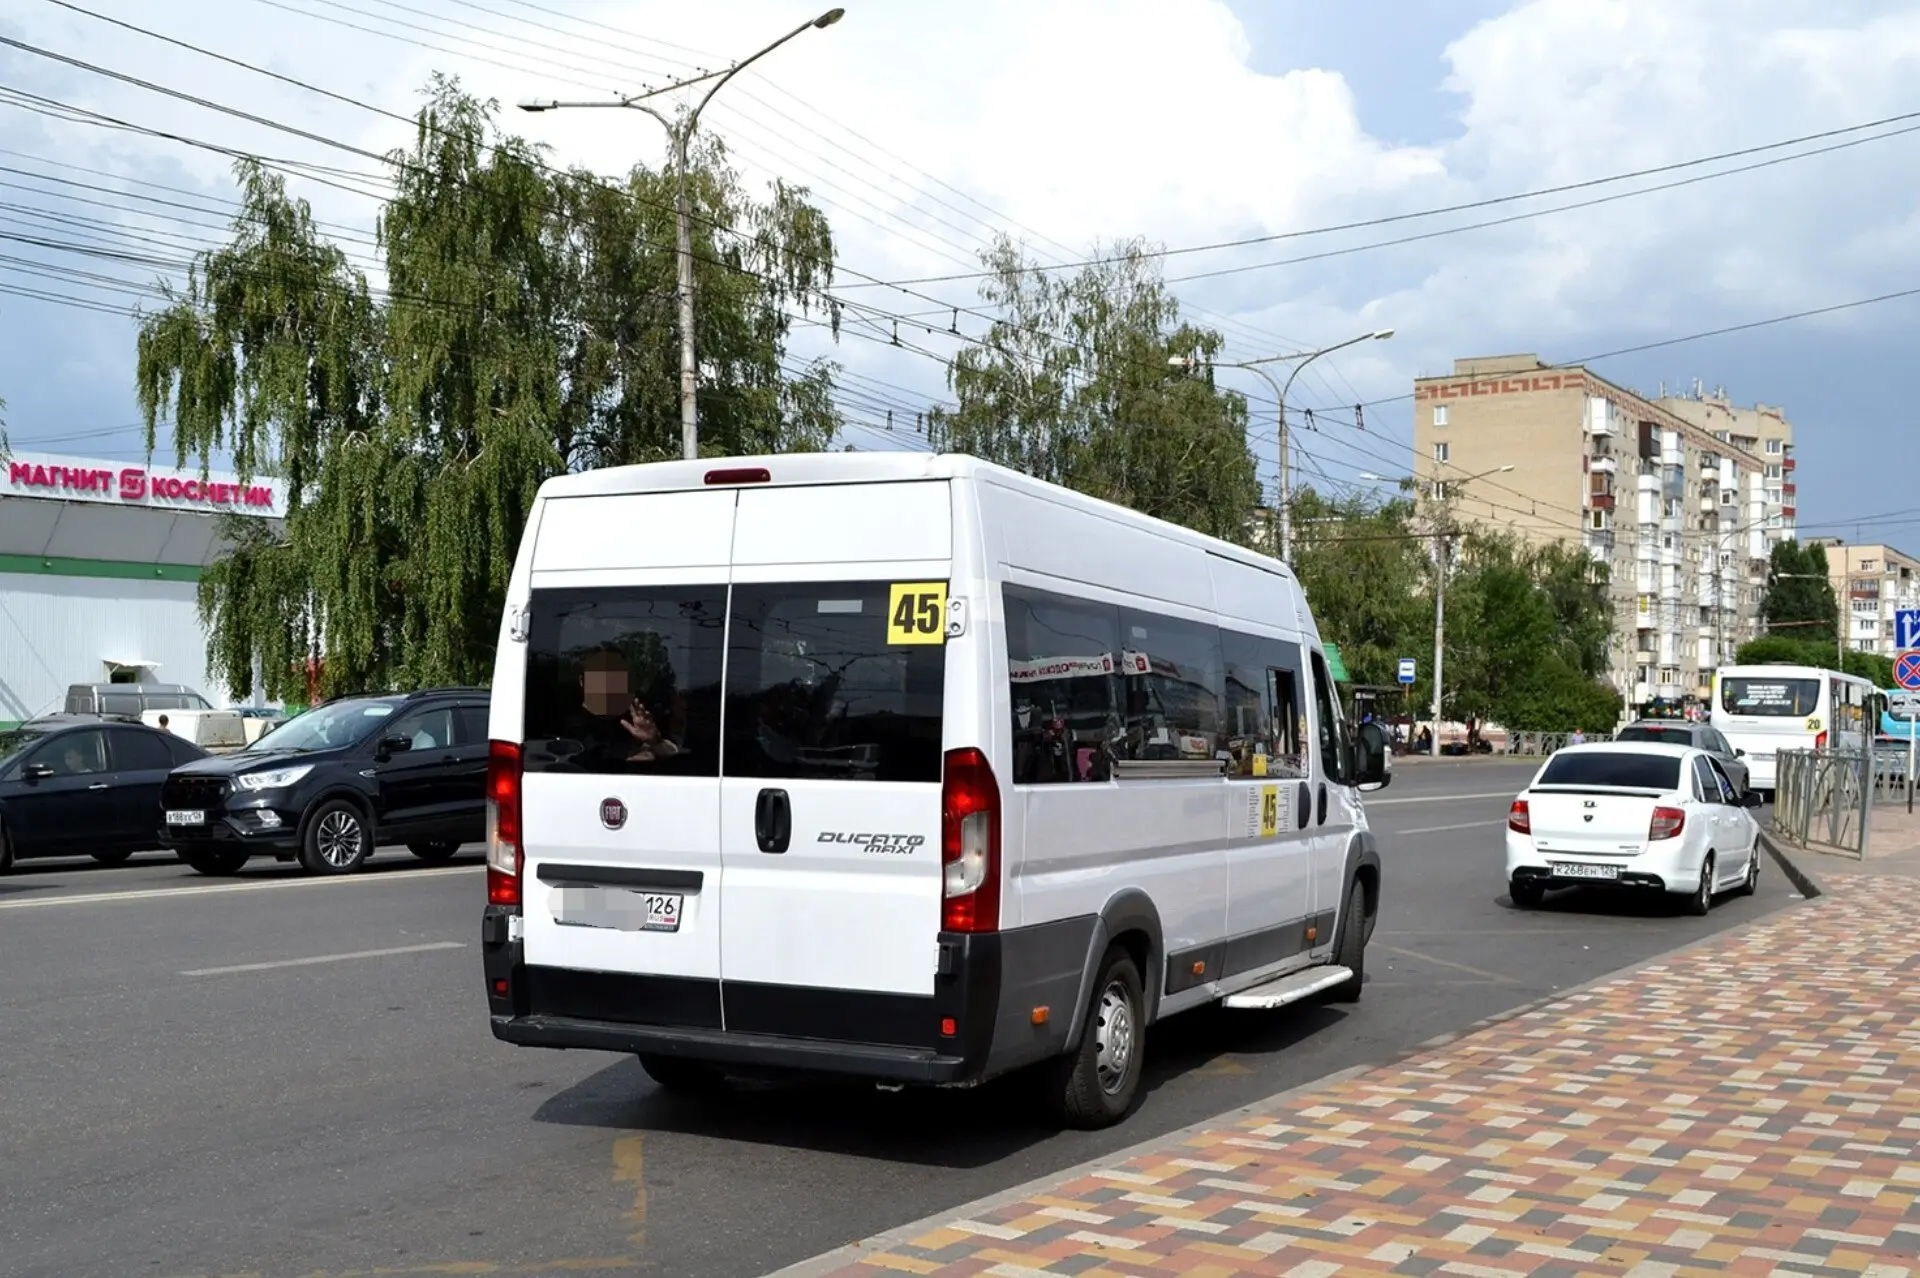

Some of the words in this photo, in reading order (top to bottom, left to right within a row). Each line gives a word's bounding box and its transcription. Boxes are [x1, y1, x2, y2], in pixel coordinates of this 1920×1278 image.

[9, 462, 113, 492] МАГНИТ
[152, 477, 272, 507] КОСМЕТИК
[893, 593, 940, 634] 45
[1807, 718, 1821, 730] 20
[605, 805, 621, 820] FIAT
[1263, 793, 1277, 829] 45
[817, 832, 925, 846] DUCATO
[863, 844, 915, 854] MAXI
[646, 896, 674, 915] 126
